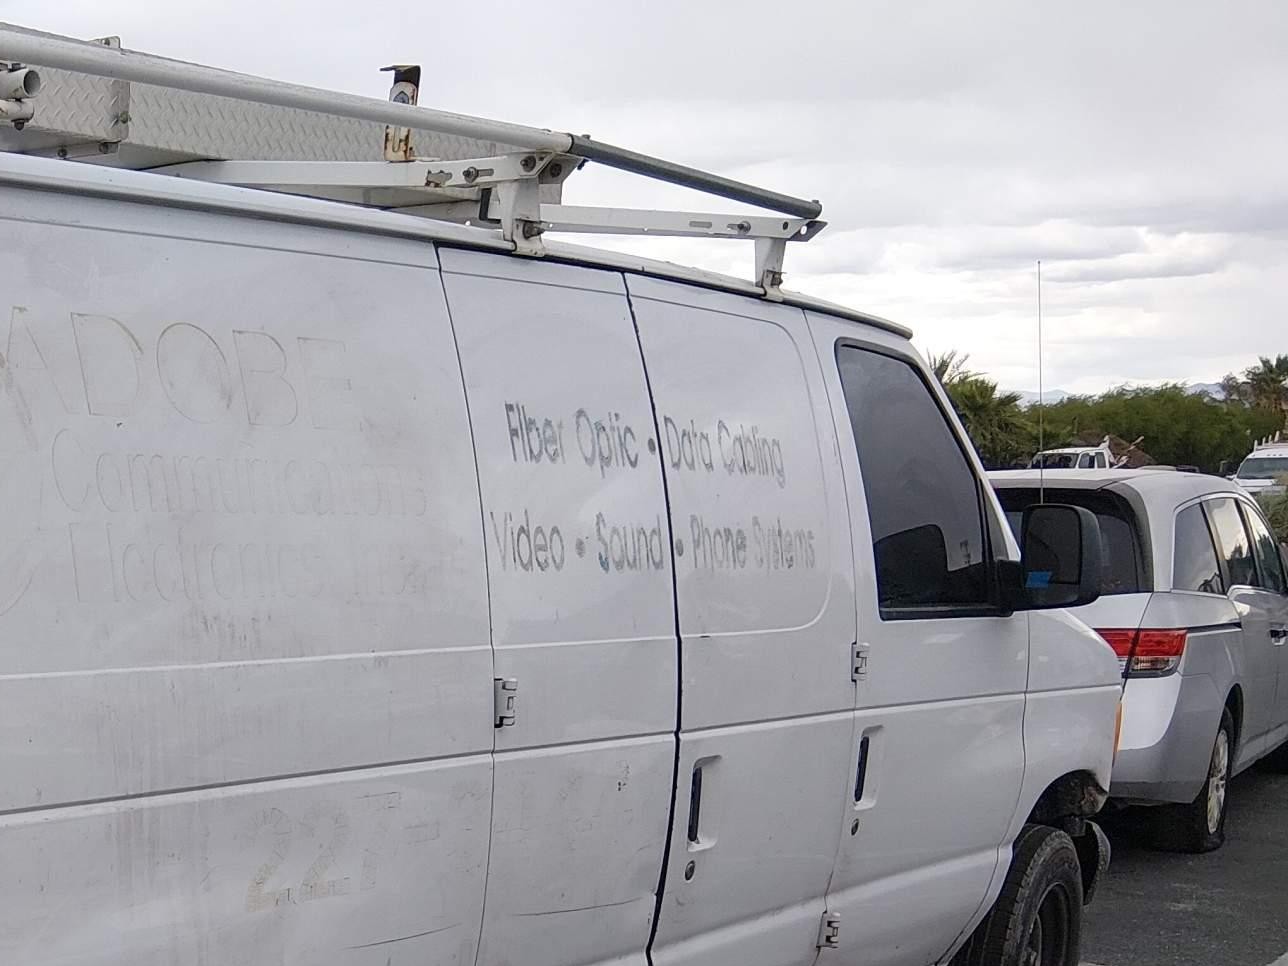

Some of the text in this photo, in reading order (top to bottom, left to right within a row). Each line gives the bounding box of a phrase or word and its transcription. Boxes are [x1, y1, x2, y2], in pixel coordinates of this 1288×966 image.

[6, 305, 358, 430] ADOBE
[576, 408, 639, 479] Optic
[662, 415, 714, 472] Data
[717, 418, 785, 488] Cabling
[490, 509, 815, 576] Video Sound Phone Systems
